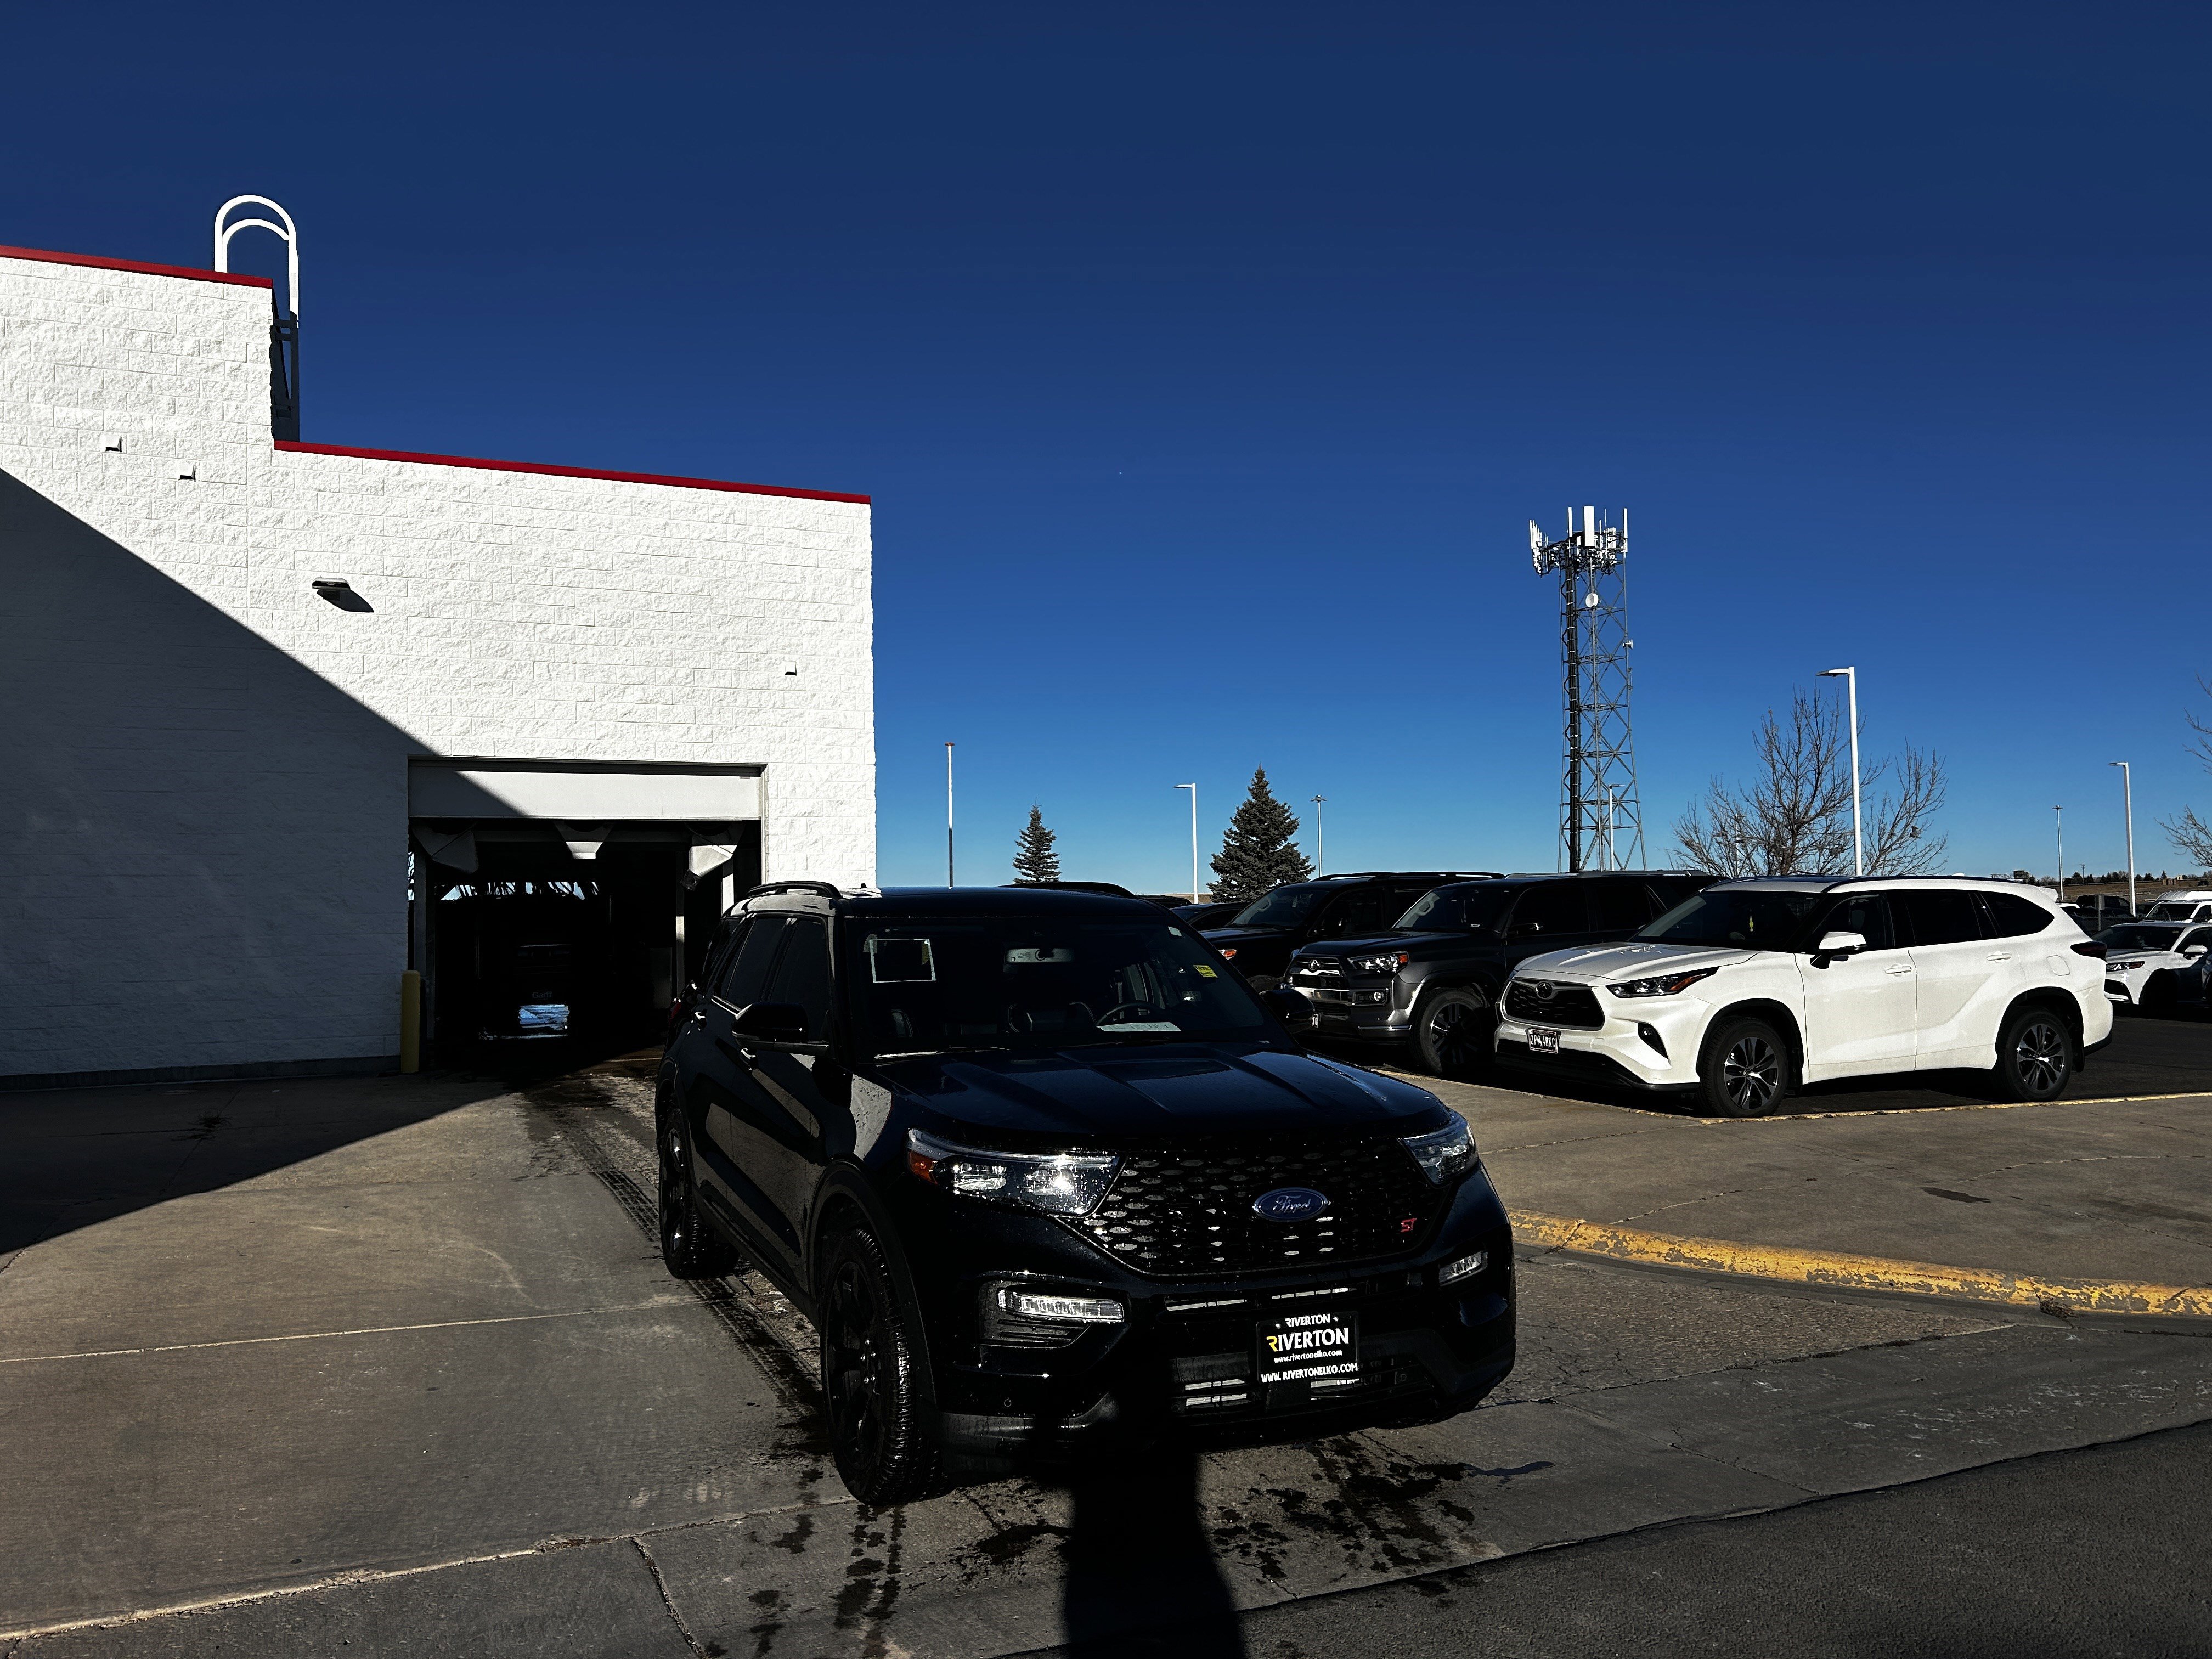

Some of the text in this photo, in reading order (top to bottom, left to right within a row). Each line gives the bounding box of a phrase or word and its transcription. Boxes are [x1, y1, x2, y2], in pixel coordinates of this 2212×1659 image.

[1272, 1195, 1312, 1213] Ford
[1400, 1217, 1418, 1233] ST
[1285, 1313, 1330, 1328] RIVERTON
[1266, 1327, 1349, 1352] RIVERTON
[1274, 1350, 1342, 1364] www.rivertonelko.com
